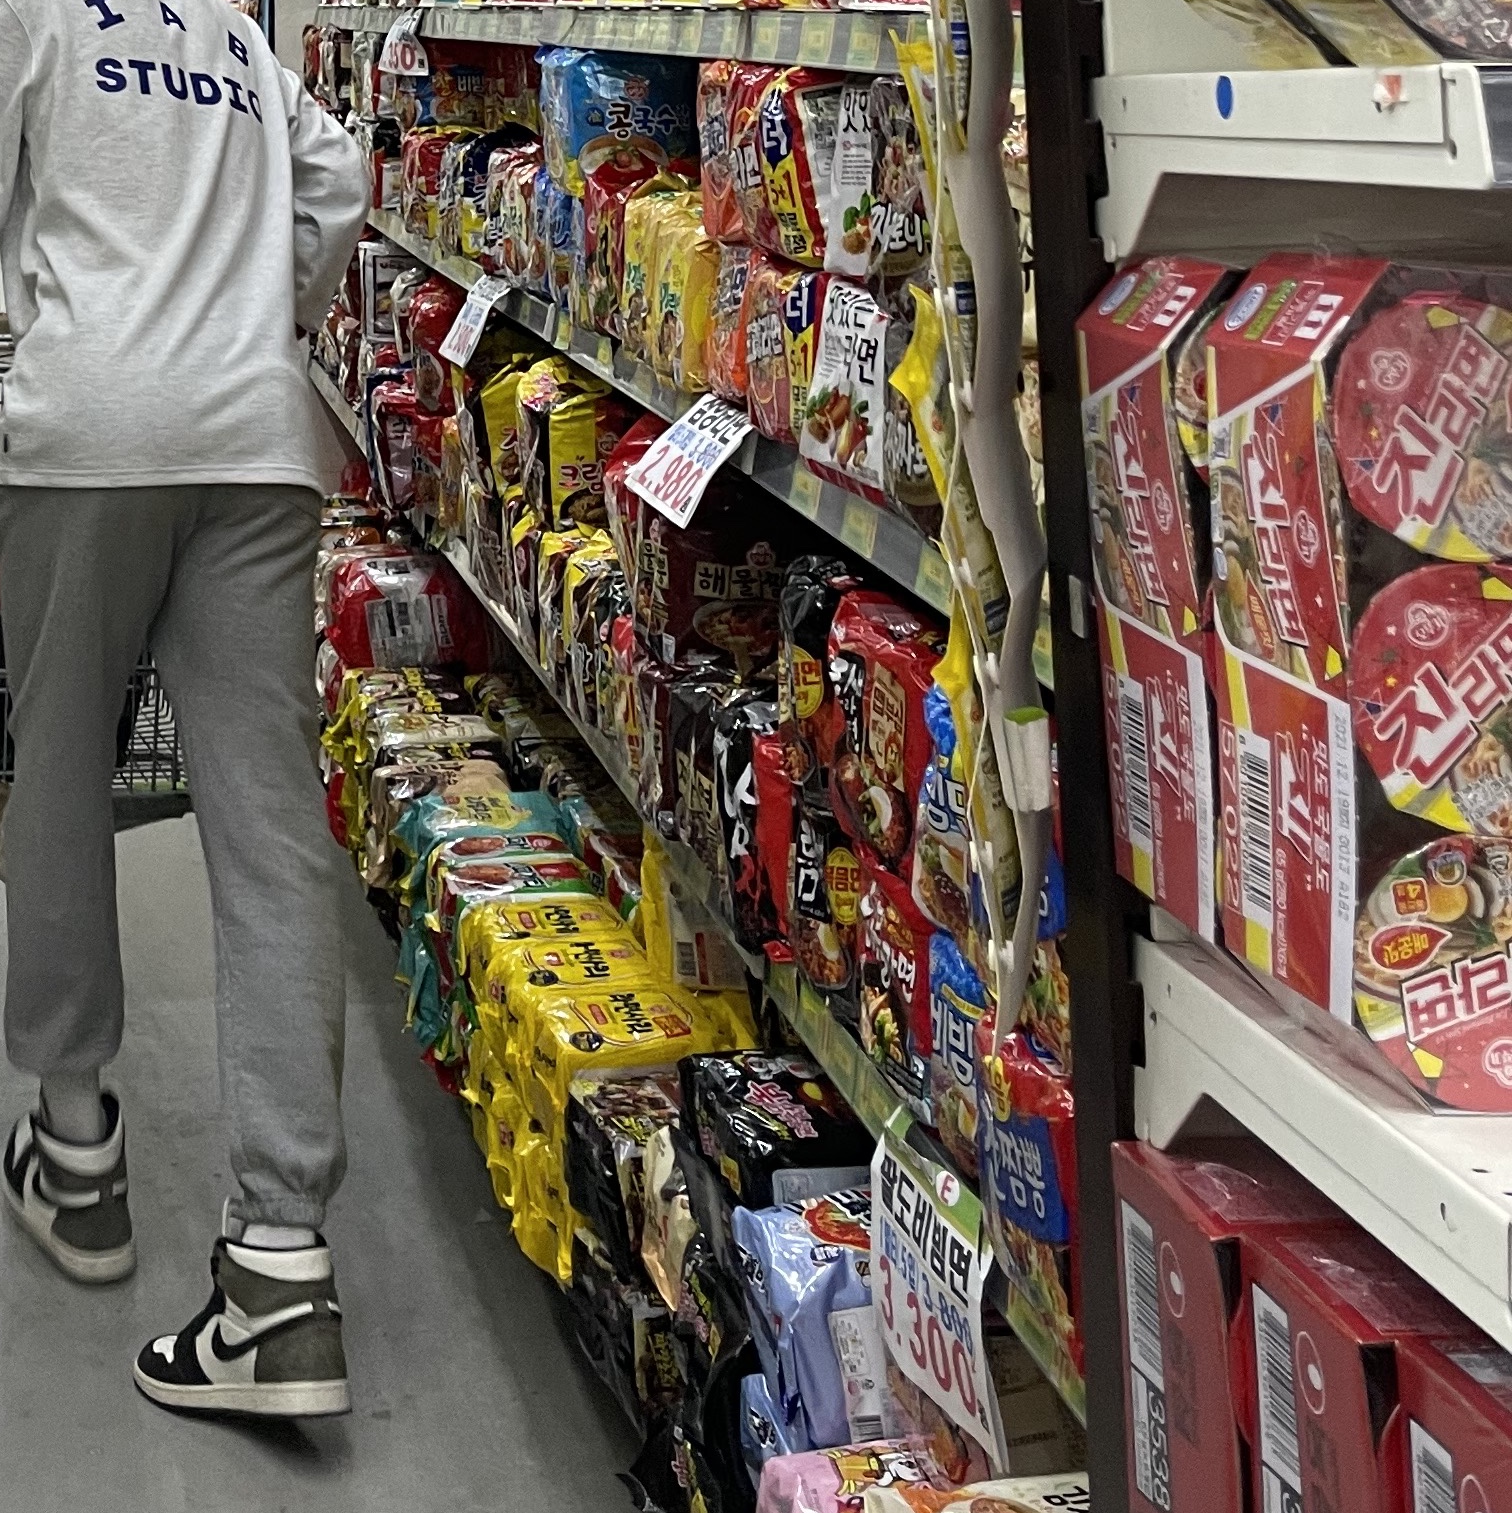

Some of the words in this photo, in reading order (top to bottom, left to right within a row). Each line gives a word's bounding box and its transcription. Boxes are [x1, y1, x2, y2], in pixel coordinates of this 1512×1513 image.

[159, 1, 186, 32] A
[227, 30, 249, 67] B
[606, 97, 679, 140] 콩국수
[1372, 322, 1508, 527] 진라면
[1223, 726, 1239, 790] 57
[1225, 806, 1241, 909] 022
[937, 1174, 955, 1205] E
[1148, 1390, 1171, 1511] 3538
